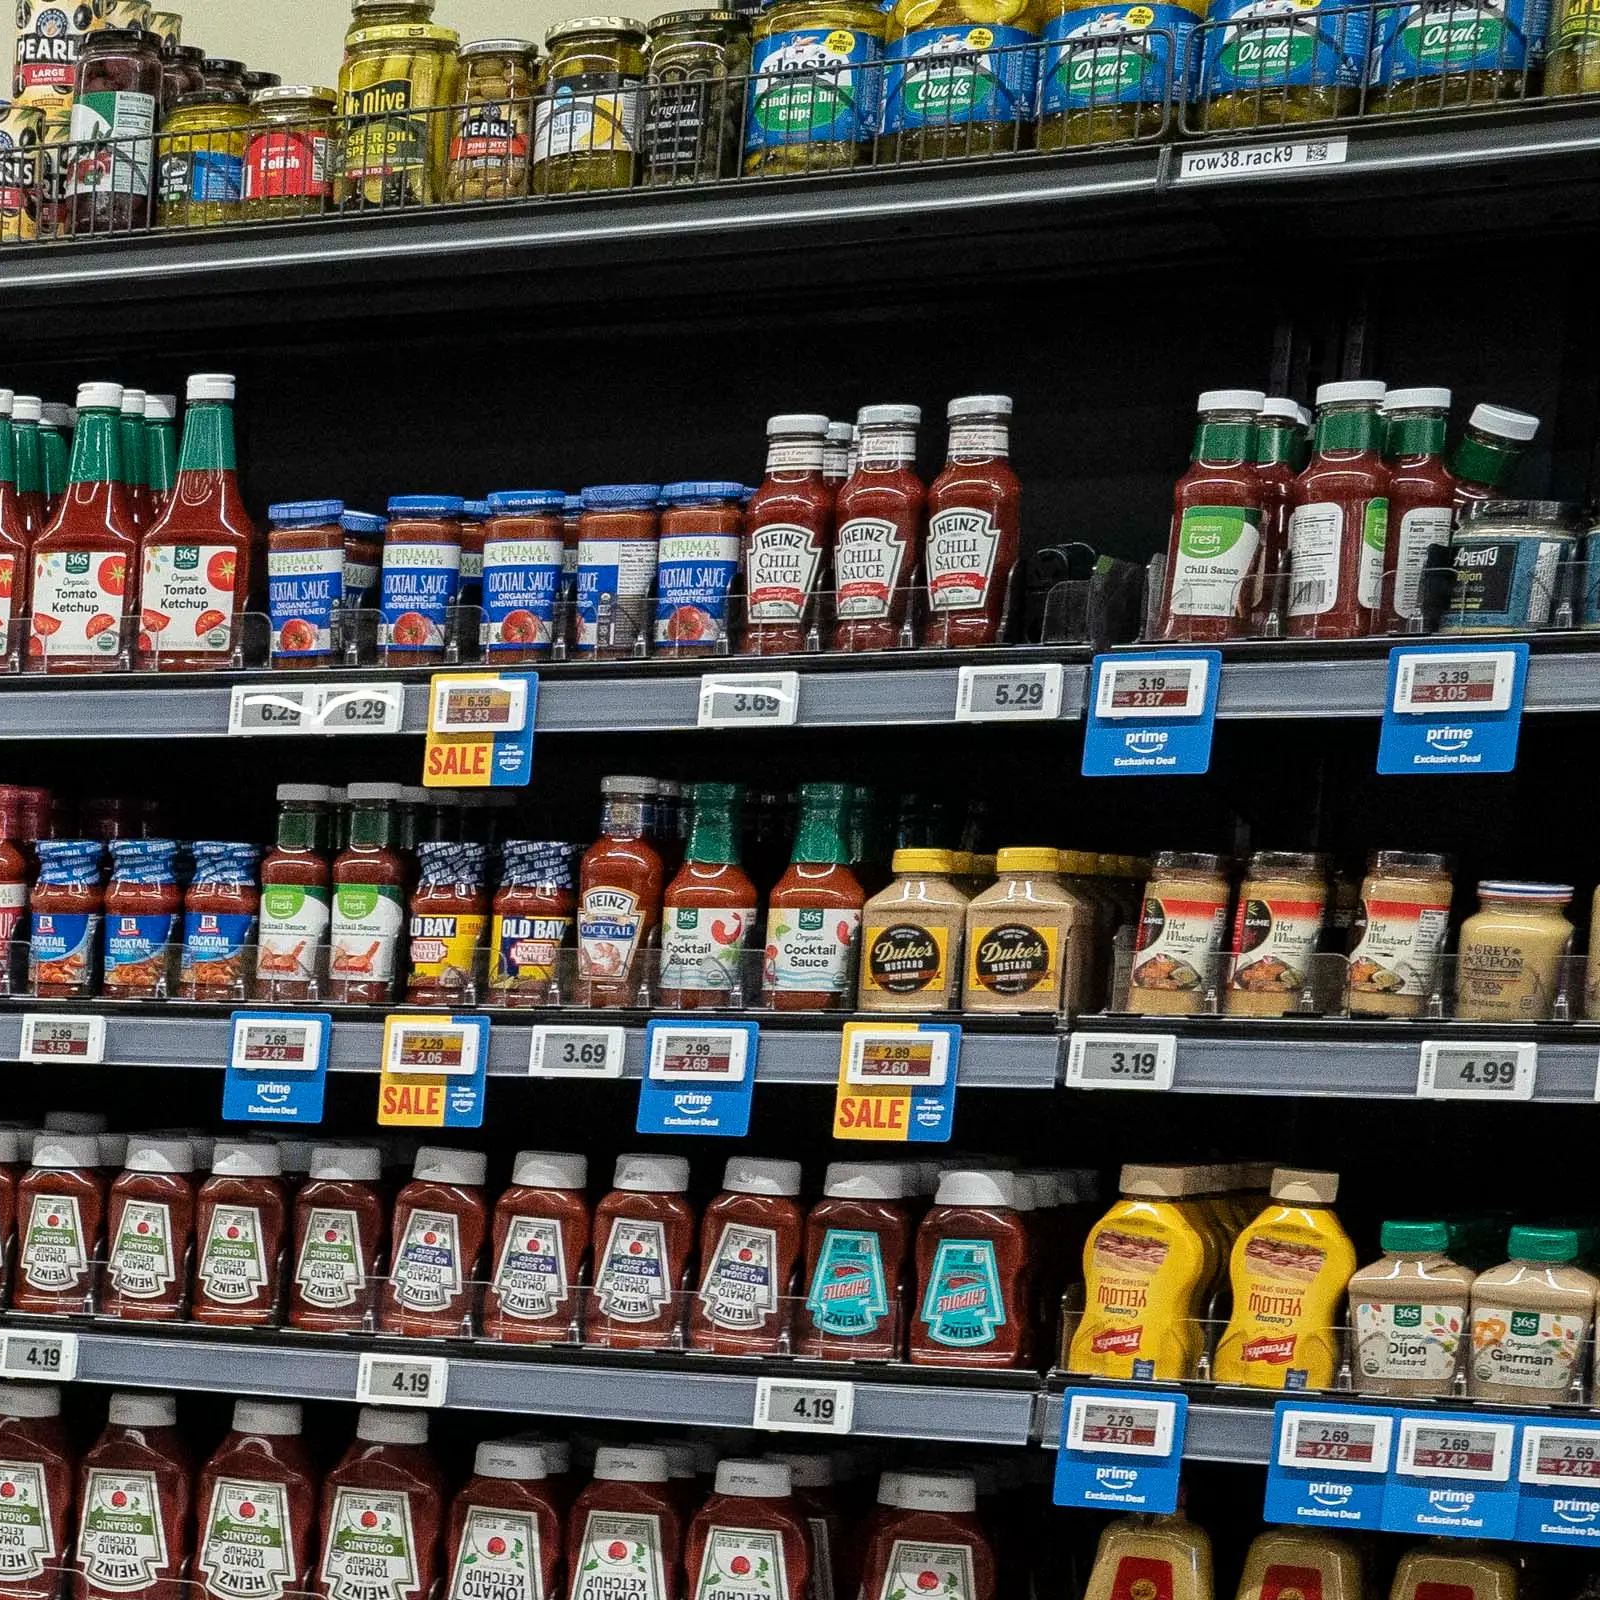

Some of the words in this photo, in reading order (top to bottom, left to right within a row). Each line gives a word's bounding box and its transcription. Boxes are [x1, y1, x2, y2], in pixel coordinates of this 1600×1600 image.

[31, 68, 65, 79] LARGE
[1188, 147, 1293, 174] row38.rack9
[936, 517, 984, 537] HEINZ
[758, 533, 806, 553] HEINZ
[936, 538, 978, 554] CHILI
[1188, 530, 1221, 547] fresh
[758, 553, 800, 569] CHILI
[934, 553, 981, 569] SAUCE
[755, 568, 803, 585] SAUCE
[1184, 565, 1208, 576] Chili
[1211, 565, 1240, 576] Sauce
[55, 588, 97, 600] Tomato
[51, 600, 99, 615] Ketchup
[1138, 676, 1167, 691] 3.19
[1438, 670, 1470, 684] 3.39
[466, 693, 492, 708] 6.59
[994, 683, 1045, 706] 5.29
[1133, 692, 1164, 706] 2.87
[1433, 685, 1468, 701] 3.05
[733, 692, 780, 715] 3.69
[463, 709, 490, 724] 5.93
[1125, 730, 1168, 747] prime
[1426, 726, 1473, 744] prime
[427, 745, 489, 777] SALE
[1113, 755, 1153, 767] Exclusive
[1156, 755, 1176, 767] Deal
[1413, 753, 1455, 765] Exclusive
[1459, 753, 1482, 764] Deal
[588, 894, 627, 911] HEINZ
[800, 910, 822, 923] 365
[581, 923, 635, 938] COCKTAIL
[1168, 919, 1187, 932] Hot
[1167, 929, 1208, 947] Mustard
[784, 943, 837, 957] Cocktail
[979, 938, 1044, 963] Duke's
[790, 955, 829, 969] Sauce
[50, 1028, 73, 1040] 3.99
[264, 1035, 288, 1046] 2.69
[47, 1041, 71, 1054] 3.59
[260, 1047, 286, 1061] 2.42
[562, 1042, 606, 1064] 3.69
[884, 1047, 910, 1059] 2.89
[881, 1061, 909, 1075] 2.60
[1110, 1053, 1156, 1076] 3.19
[1459, 1061, 1516, 1084] 4.99
[382, 1087, 439, 1116] SALE
[1396, 1308, 1420, 1322] 365
[1512, 1315, 1538, 1329] 365
[26, 1346, 61, 1367] 4.19
[1491, 1350, 1553, 1367] German
[1499, 1364, 1541, 1378] Mustard
[1106, 1414, 1134, 1428] 2.79
[1096, 1467, 1137, 1484] prime
[1084, 1490, 1124, 1504] Exclusive
[1125, 1493, 1145, 1504] Deal
[464, 1568, 522, 1585] KETCHUP
